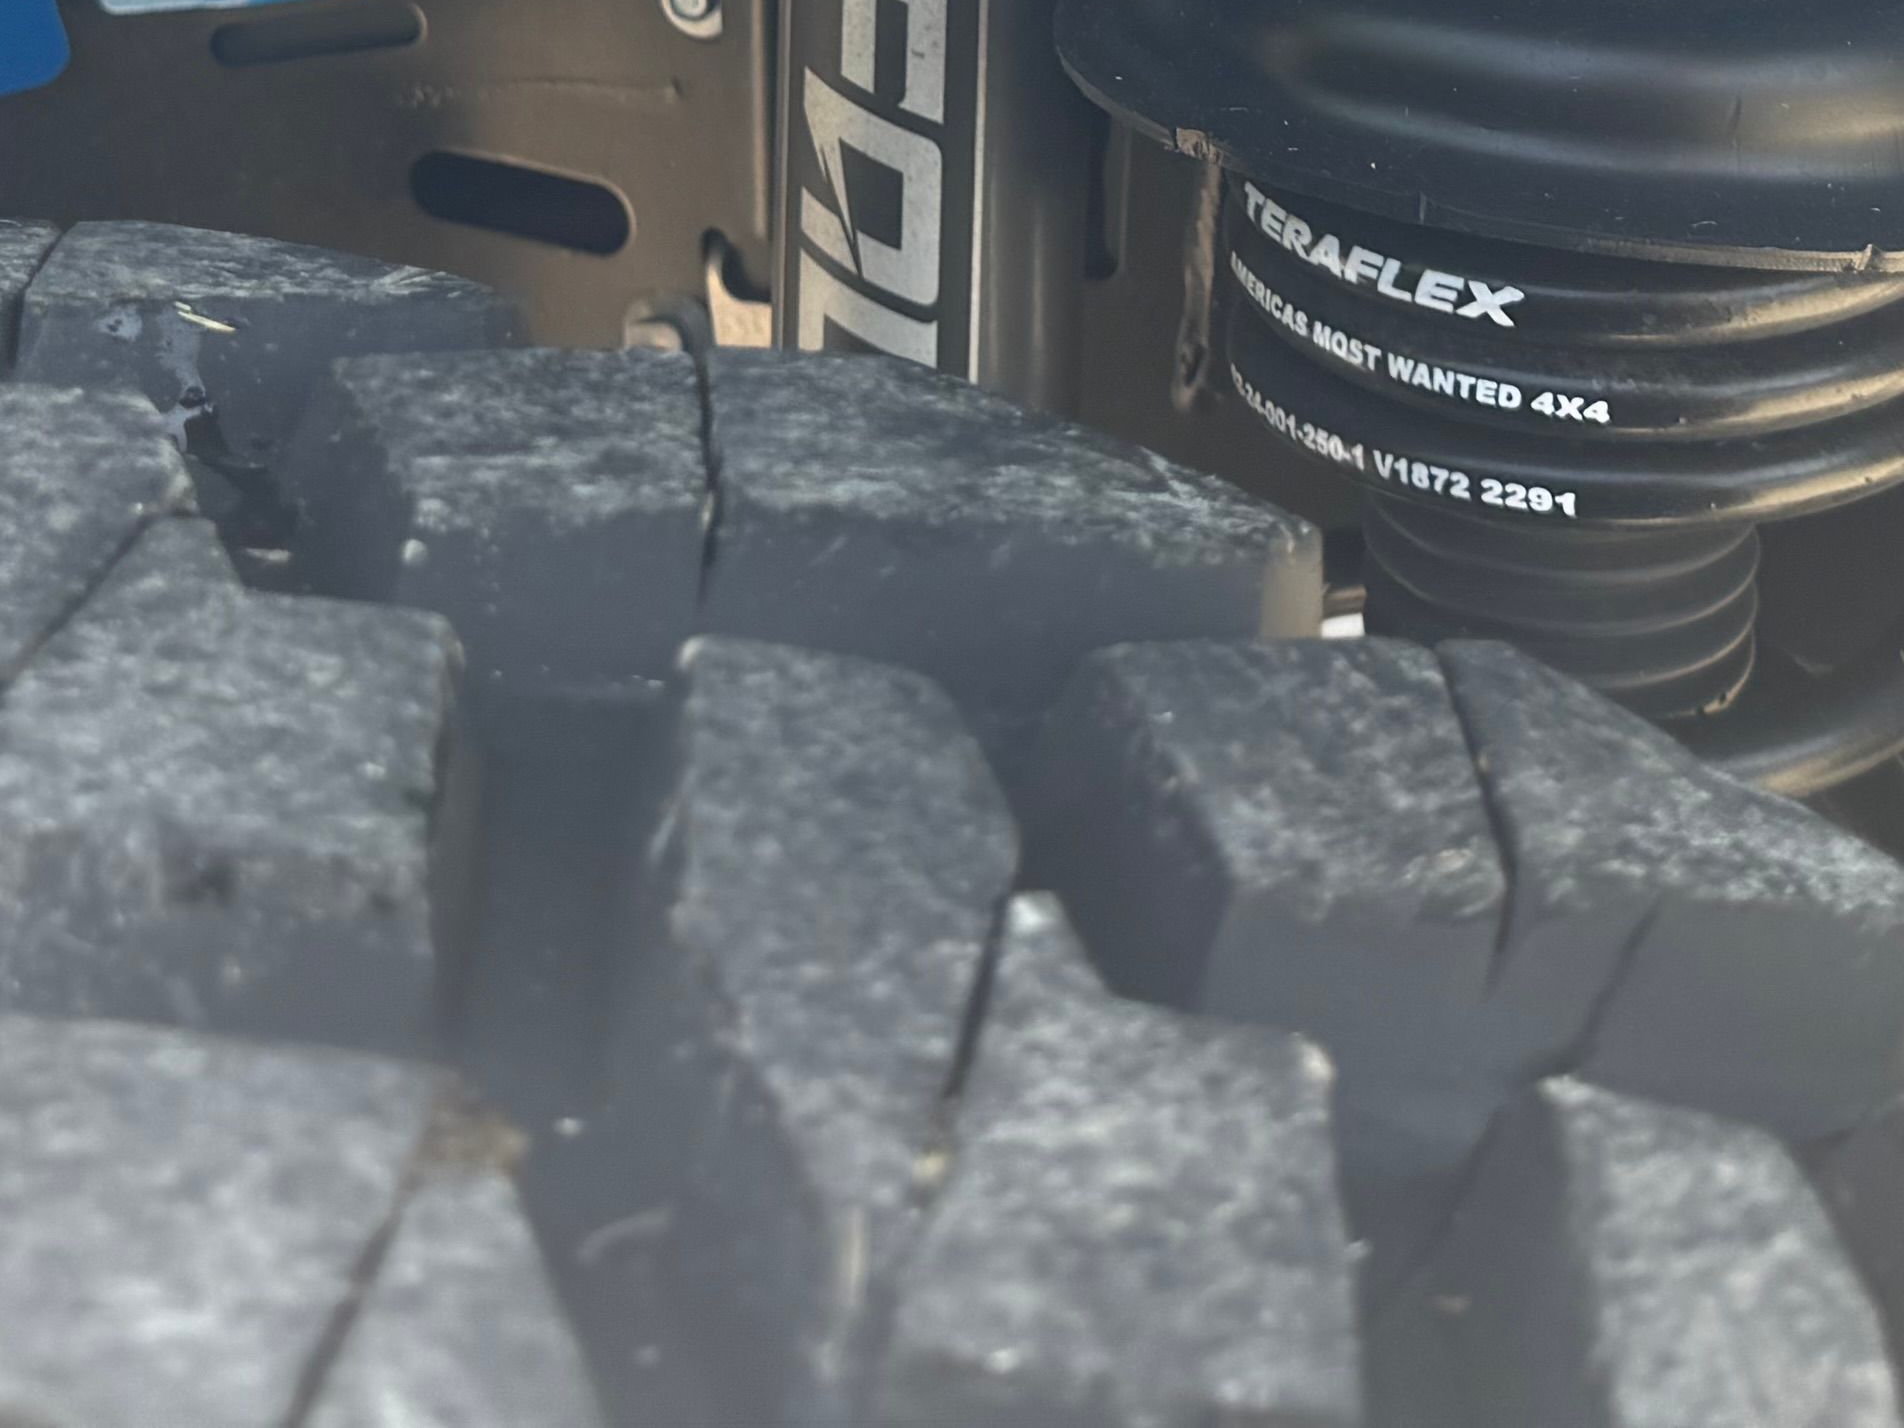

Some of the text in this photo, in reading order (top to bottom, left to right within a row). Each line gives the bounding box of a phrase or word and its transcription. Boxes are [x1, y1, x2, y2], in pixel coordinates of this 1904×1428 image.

[1243, 180, 1525, 328] TERAFLEX
[1229, 249, 1611, 425] AMERICAS MOST WANTED 4X4
[1372, 449, 1472, 502] V1872
[1479, 478, 1578, 520] 2291
